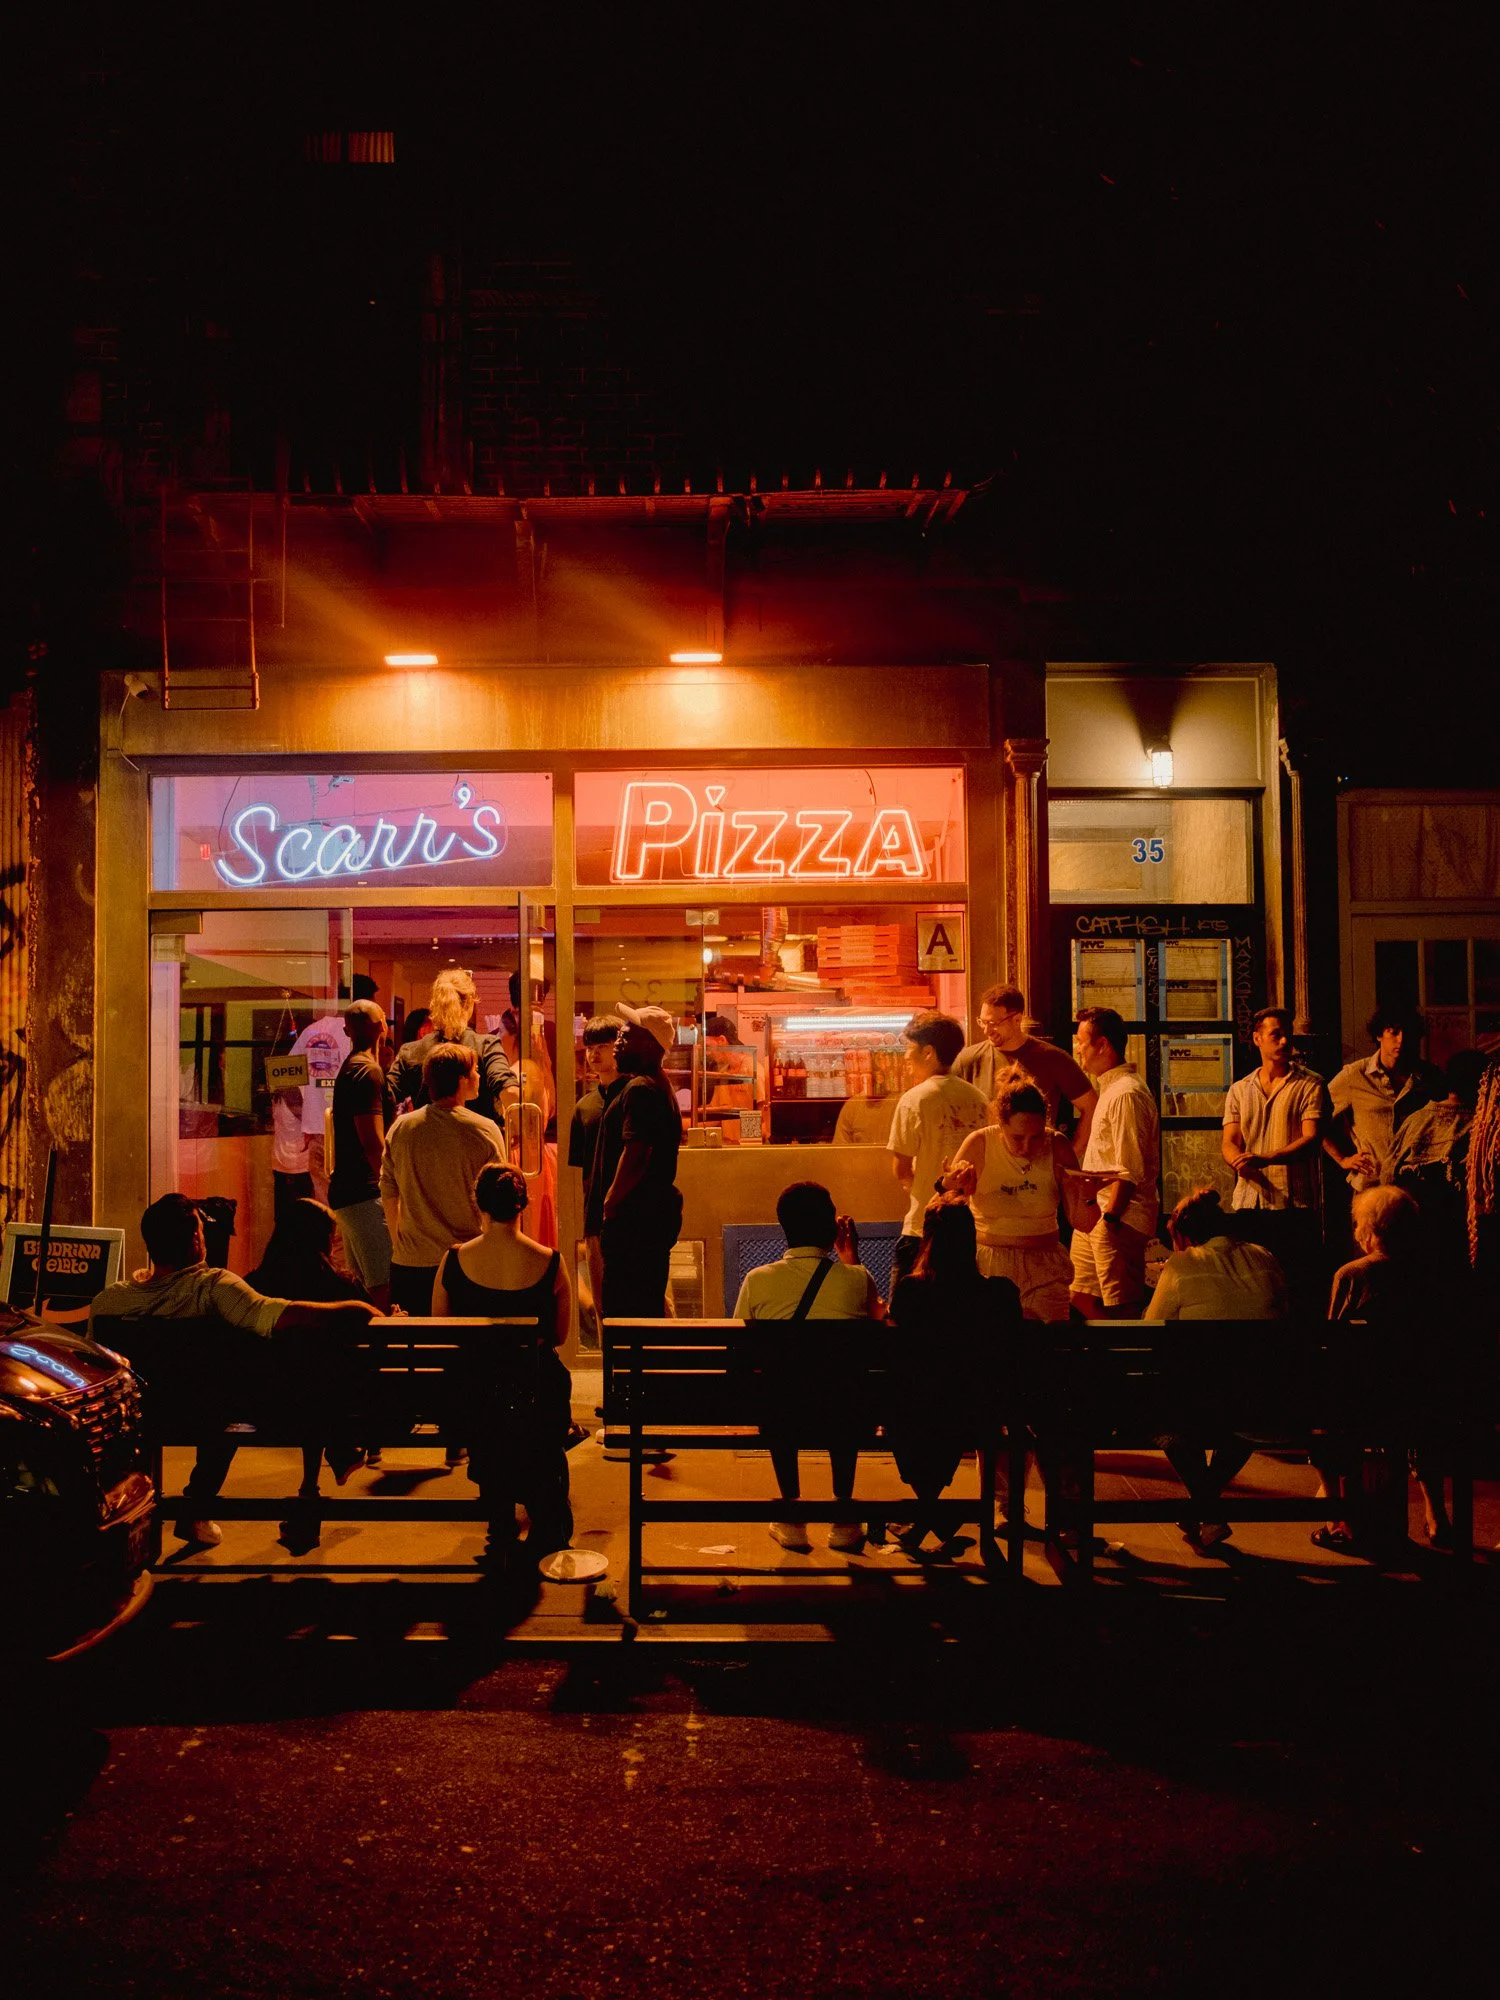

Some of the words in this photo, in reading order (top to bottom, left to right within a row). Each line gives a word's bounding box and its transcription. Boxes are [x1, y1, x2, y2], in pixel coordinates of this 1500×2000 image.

[217, 786, 501, 884] Scarr's
[1132, 838, 1165, 864] 35
[926, 923, 955, 955] A
[1081, 941, 1104, 949] NYC
[1170, 1049, 1191, 1057] NYC
[272, 1066, 303, 1077] OPEN
